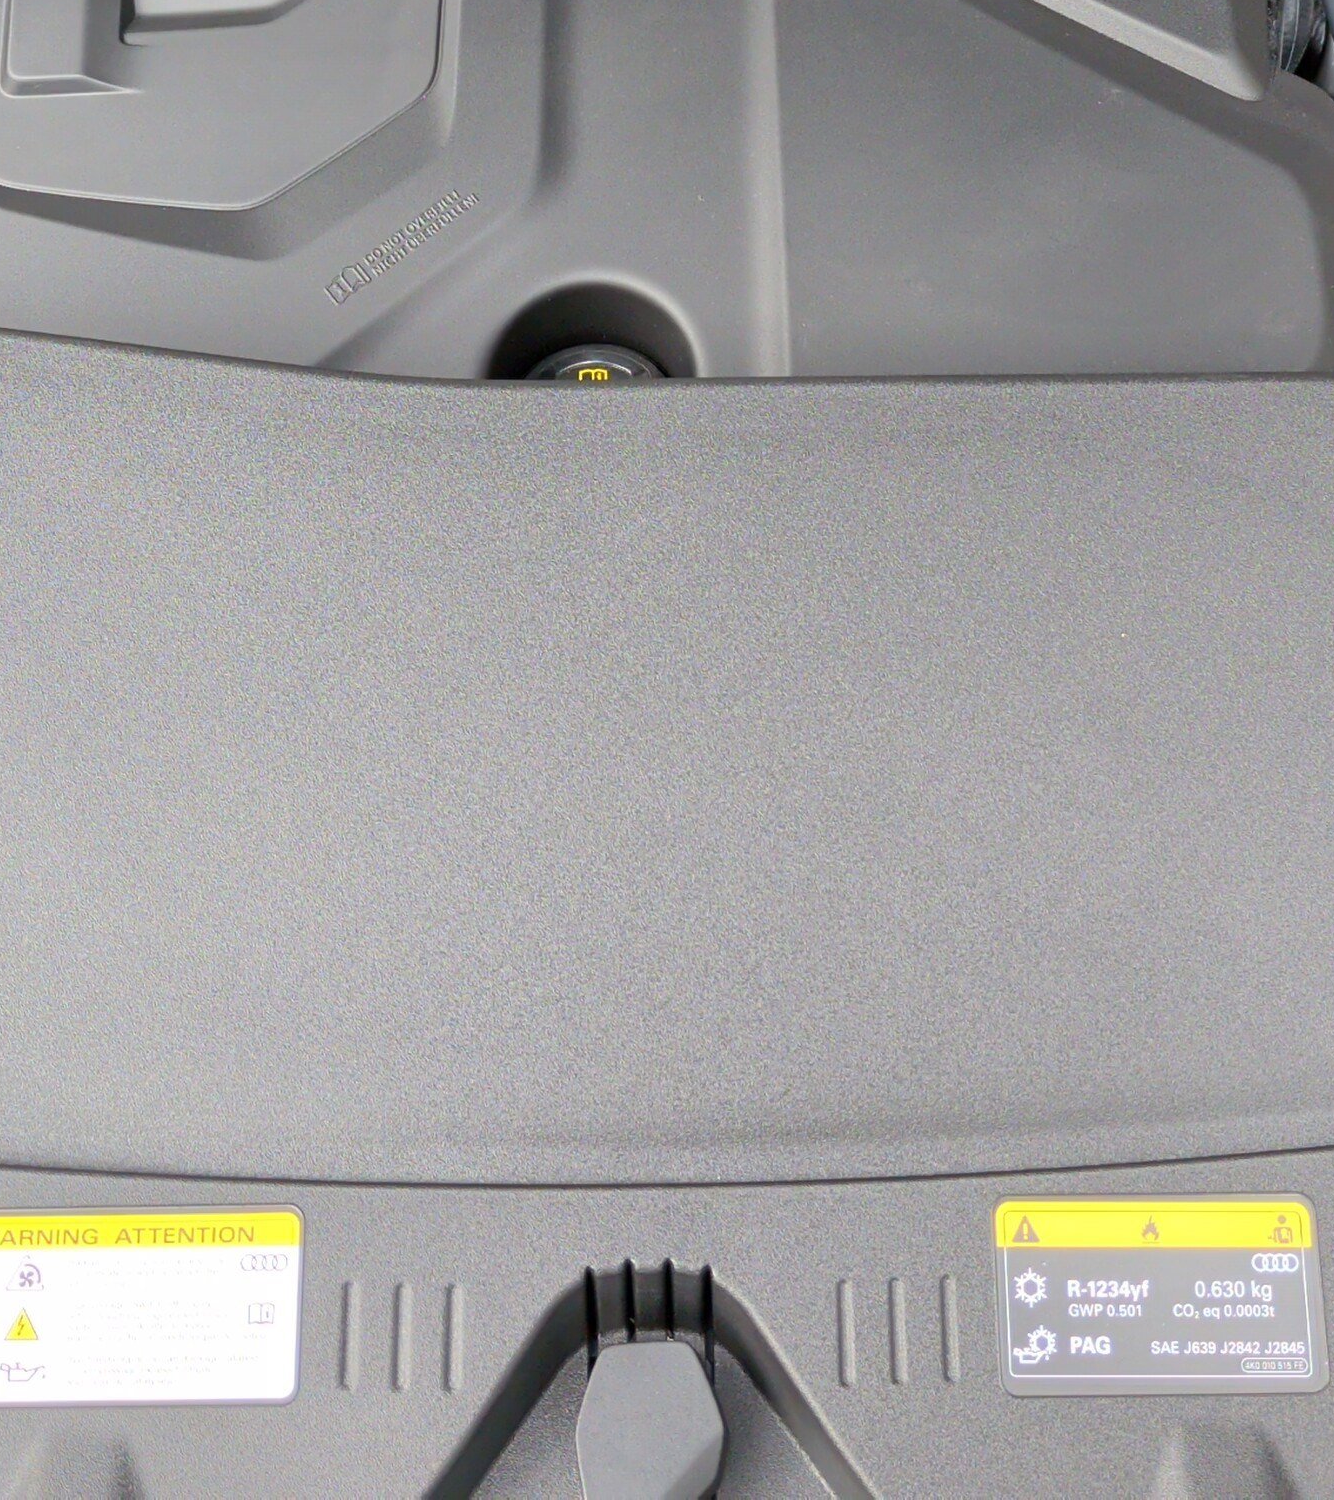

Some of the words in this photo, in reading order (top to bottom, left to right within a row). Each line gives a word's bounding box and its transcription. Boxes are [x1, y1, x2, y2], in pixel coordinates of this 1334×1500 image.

[363, 247, 383, 266] DO
[382, 228, 406, 253] NOT
[371, 245, 408, 277] NICHT
[115, 1226, 255, 1245] ATTENTION
[1067, 1279, 1150, 1301] R-1234yf
[1194, 1280, 1245, 1299] 0.630
[1250, 1280, 1272, 1302] kg
[1068, 1304, 1103, 1317] GWP
[1106, 1304, 1142, 1318] 0.501
[1203, 1307, 1220, 1320] eq
[1223, 1304, 1275, 1318] 0.0003t
[1070, 1336, 1112, 1355] PAG
[1151, 1341, 1180, 1355] SAE
[1183, 1341, 1217, 1355] J639
[1220, 1340, 1260, 1355] J2842
[1264, 1340, 1305, 1355] J2845
